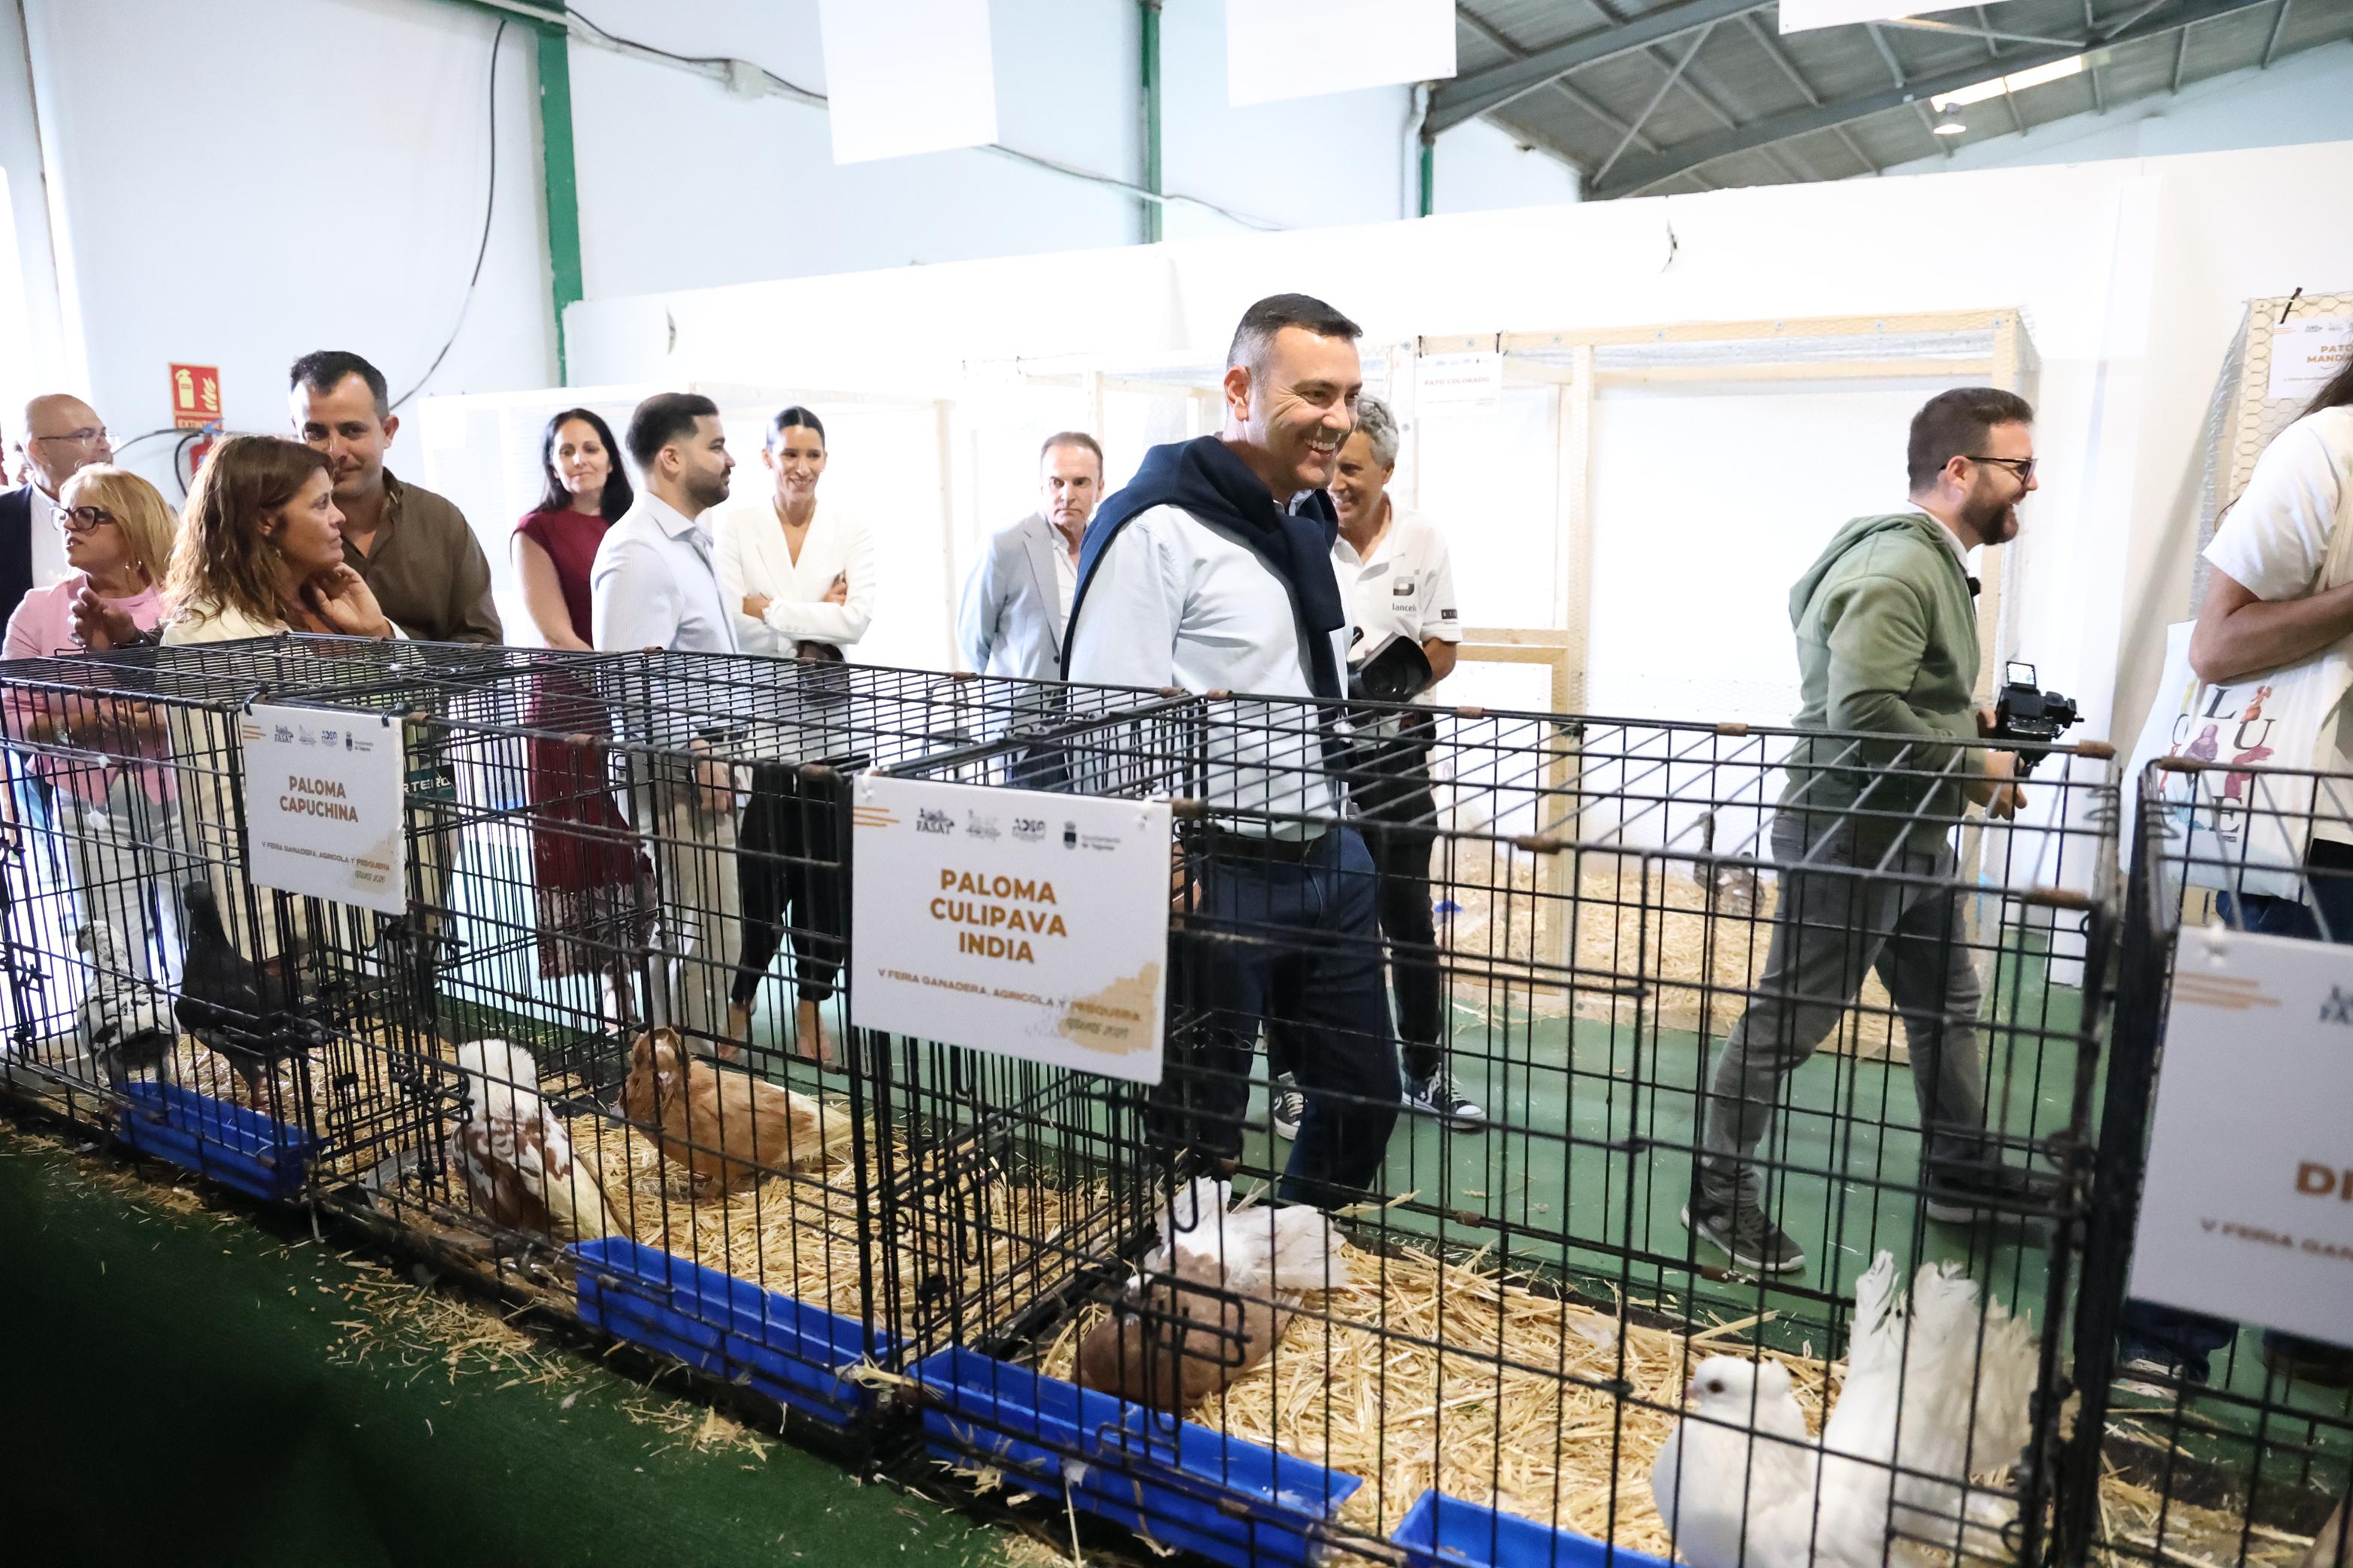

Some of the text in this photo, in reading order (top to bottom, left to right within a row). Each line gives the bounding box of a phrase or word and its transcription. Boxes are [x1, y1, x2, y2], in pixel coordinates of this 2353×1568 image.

[2321, 344, 2353, 352] PATO
[1447, 376, 1490, 385] COLORADO
[289, 775, 346, 799] PALOMA
[280, 796, 359, 823] CAPUCHINA
[940, 869, 1057, 905] PALOMA
[930, 897, 1068, 937] CULIPAVA
[959, 931, 1035, 963] INDIA
[878, 968, 885, 977] V
[888, 970, 920, 983] FERIA
[1070, 1000, 1140, 1022] PESQUERA
